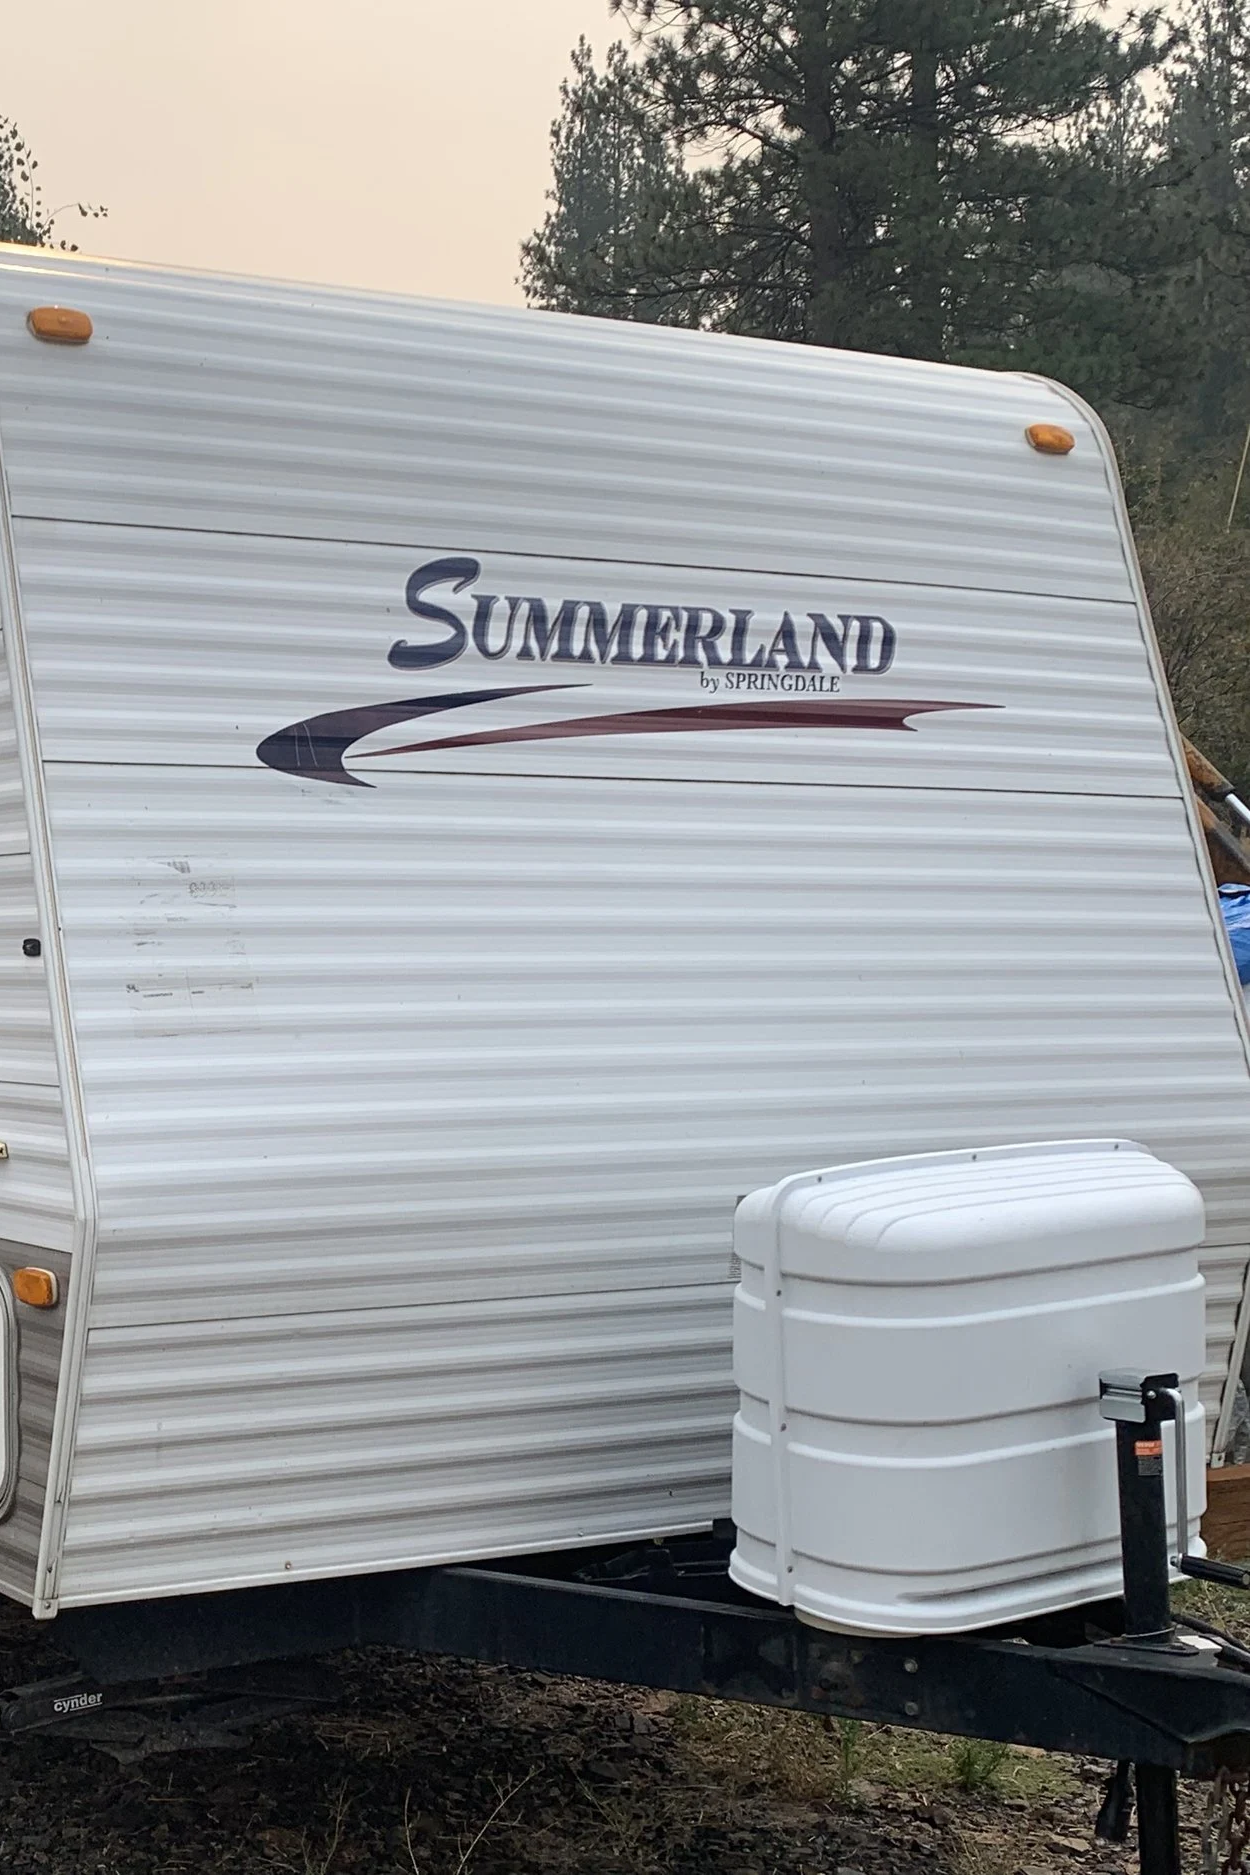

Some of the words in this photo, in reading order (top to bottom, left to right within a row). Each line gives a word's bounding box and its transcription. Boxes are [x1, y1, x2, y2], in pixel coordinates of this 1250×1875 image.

[387, 556, 898, 675] SUMMERLAND
[700, 671, 720, 693] by
[725, 672, 840, 693] SPRINGDALE
[53, 1692, 103, 1713] cynder
